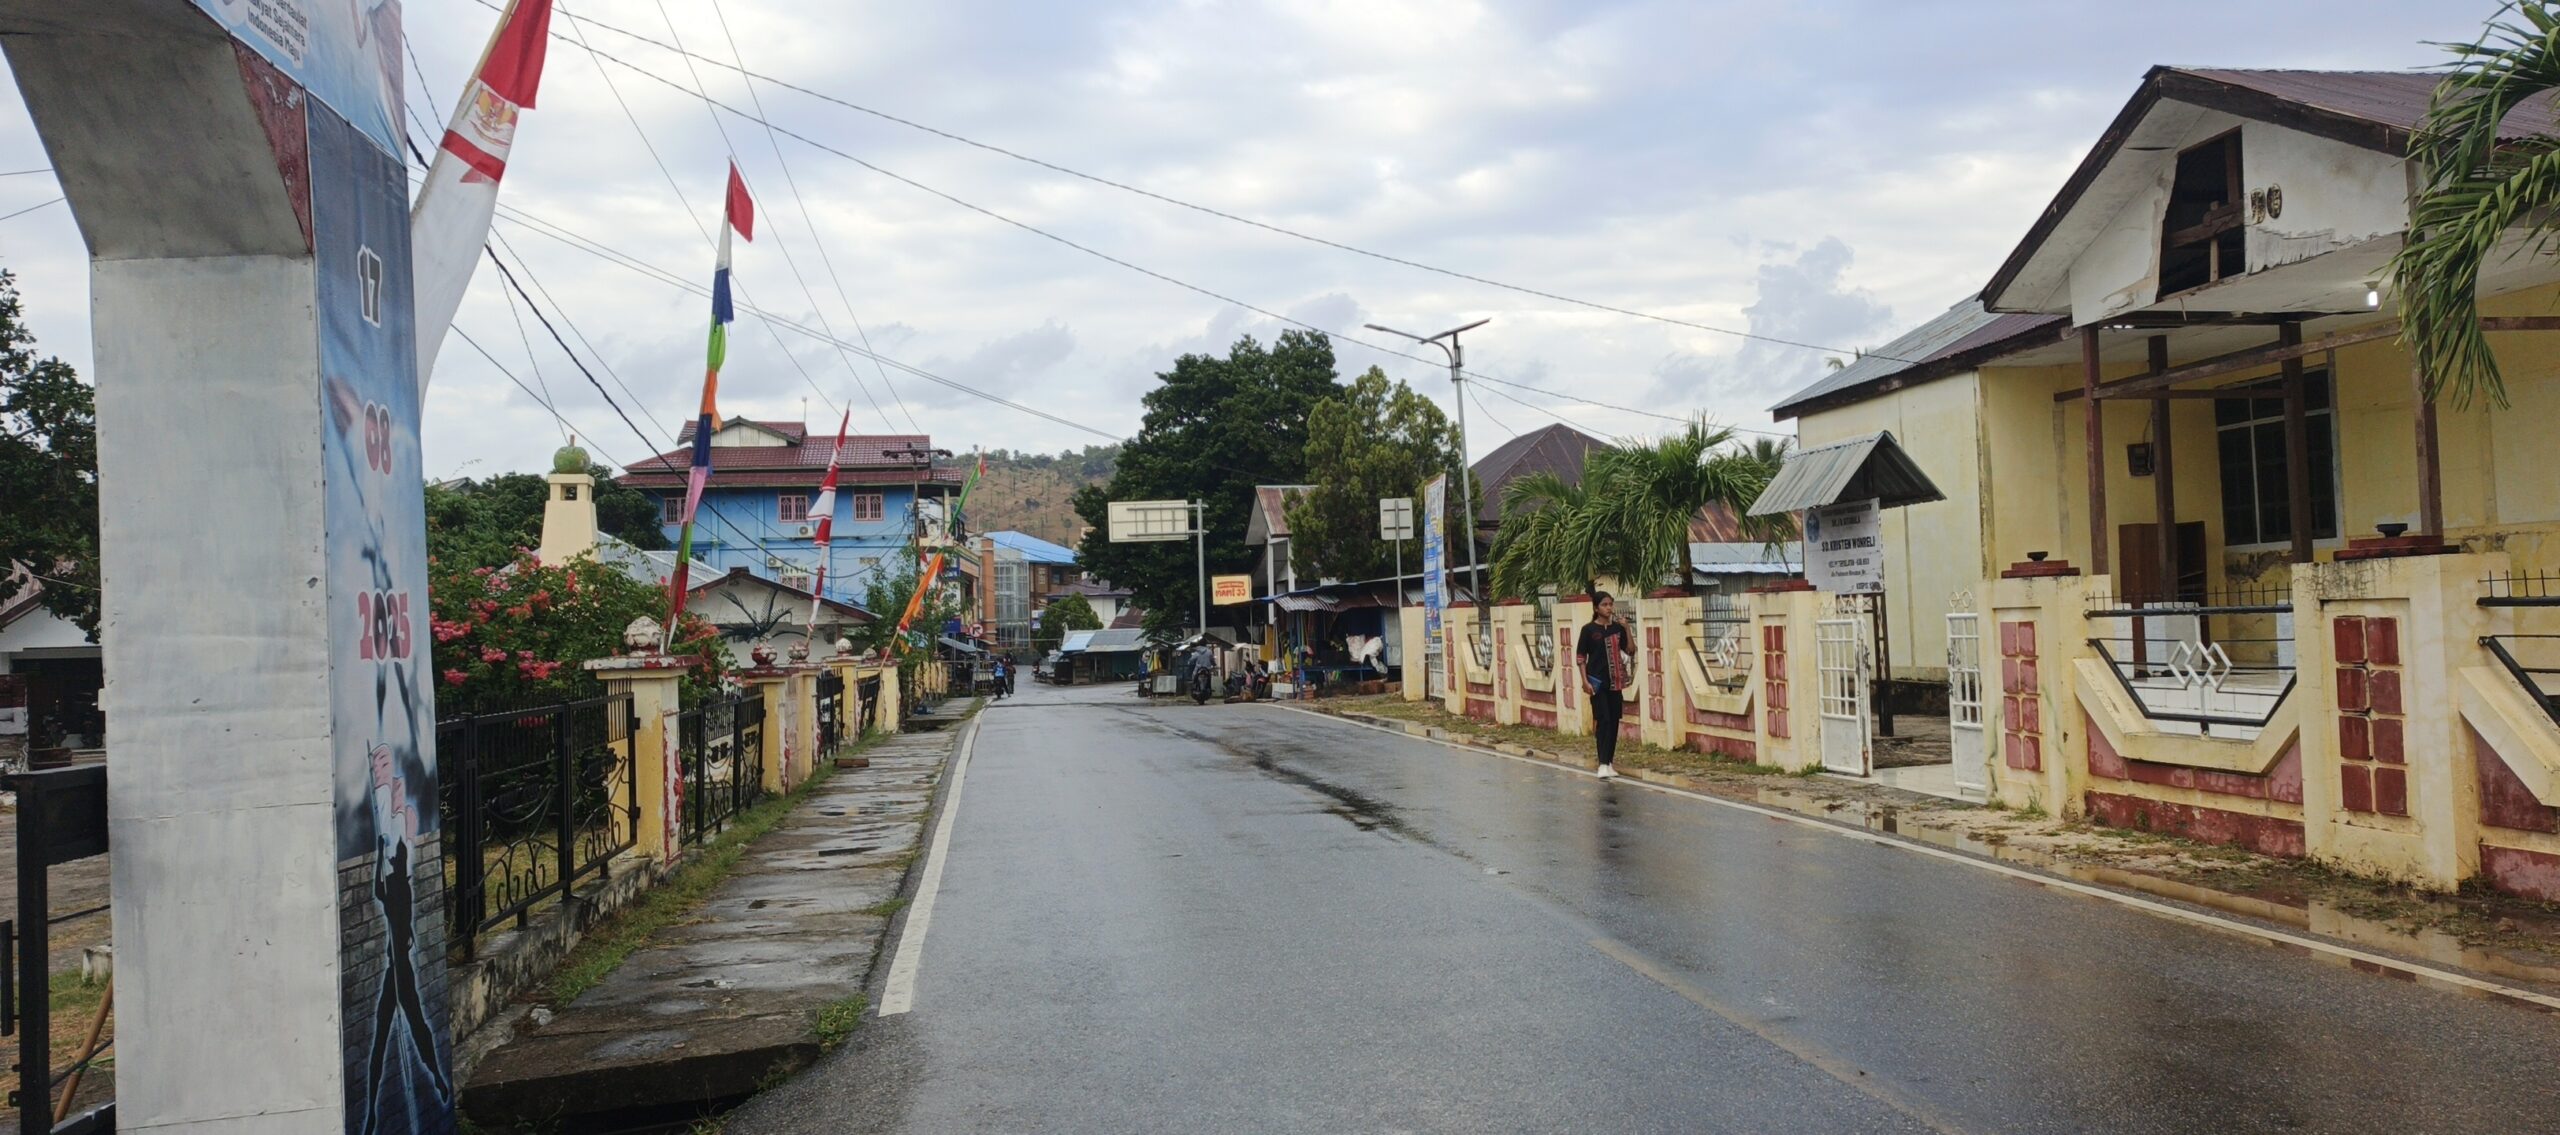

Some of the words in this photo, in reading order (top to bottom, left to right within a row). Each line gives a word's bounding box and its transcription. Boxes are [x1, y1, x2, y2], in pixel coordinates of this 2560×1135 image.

[248, 6, 283, 47] Indonesia
[357, 244, 381, 328] 17
[364, 400, 391, 476] 08
[1830, 538, 1851, 551] KRISTEN
[358, 588, 411, 663] 2025
